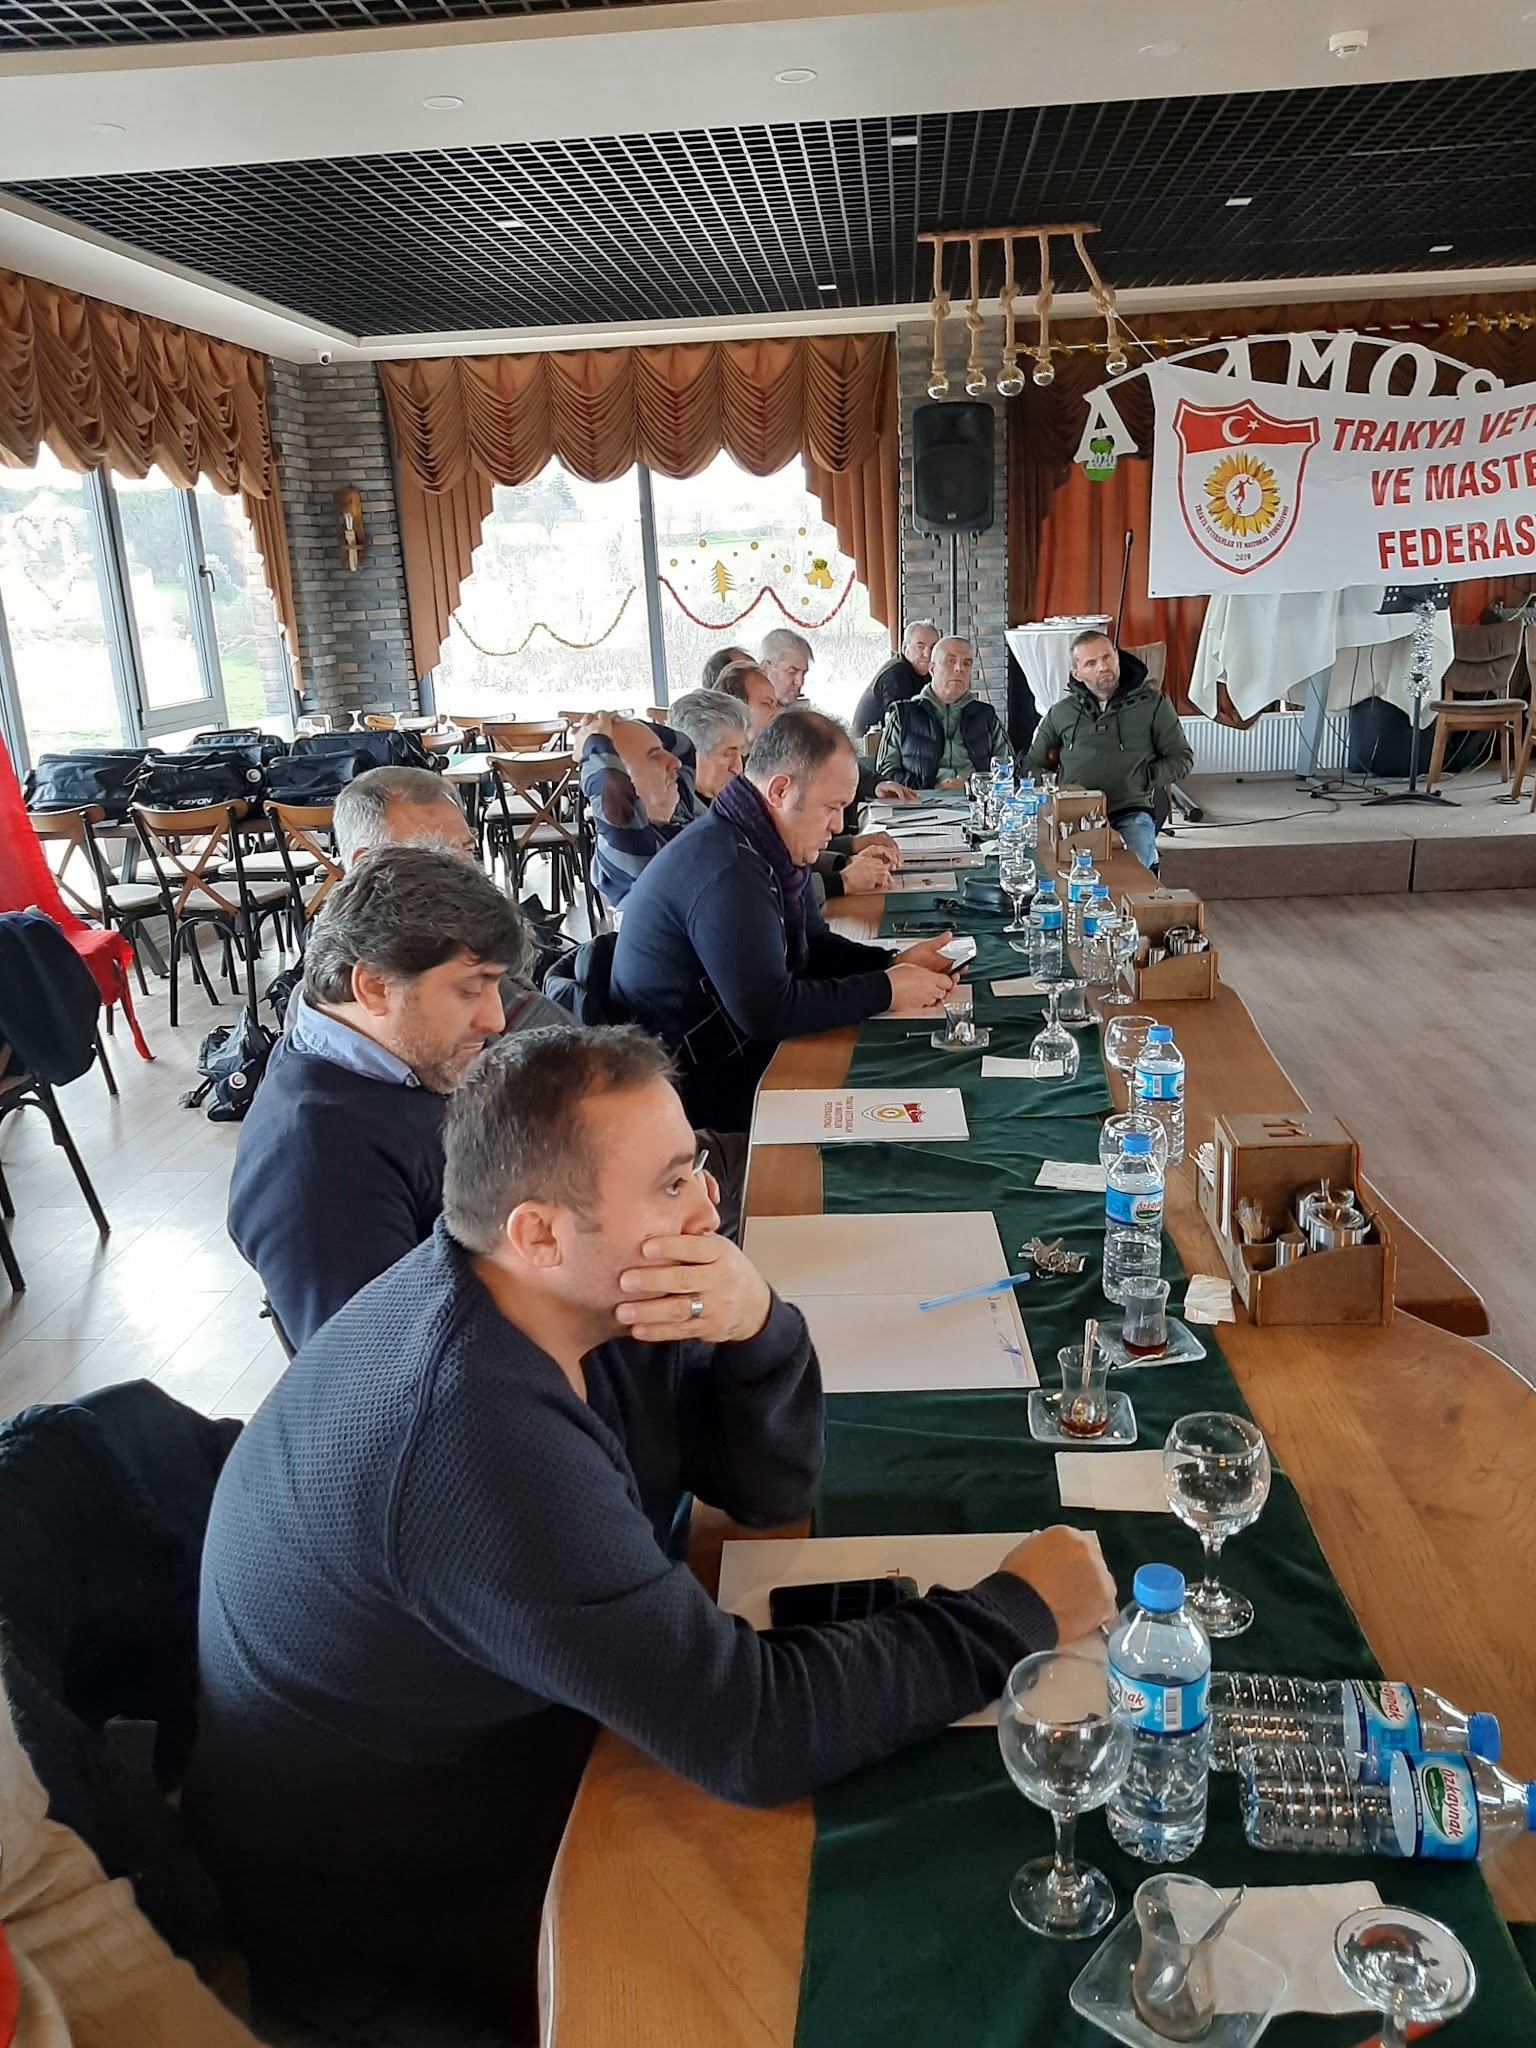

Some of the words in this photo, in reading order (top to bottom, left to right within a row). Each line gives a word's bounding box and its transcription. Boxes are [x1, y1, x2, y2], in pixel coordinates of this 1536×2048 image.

[1333, 417, 1466, 451] TRAKYA
[1479, 402, 1536, 444] VET
[1086, 452, 1115, 468] 2020
[1371, 467, 1415, 506] VE
[1235, 553, 1251, 562] 2019
[1377, 514, 1536, 570] FEDERAS
